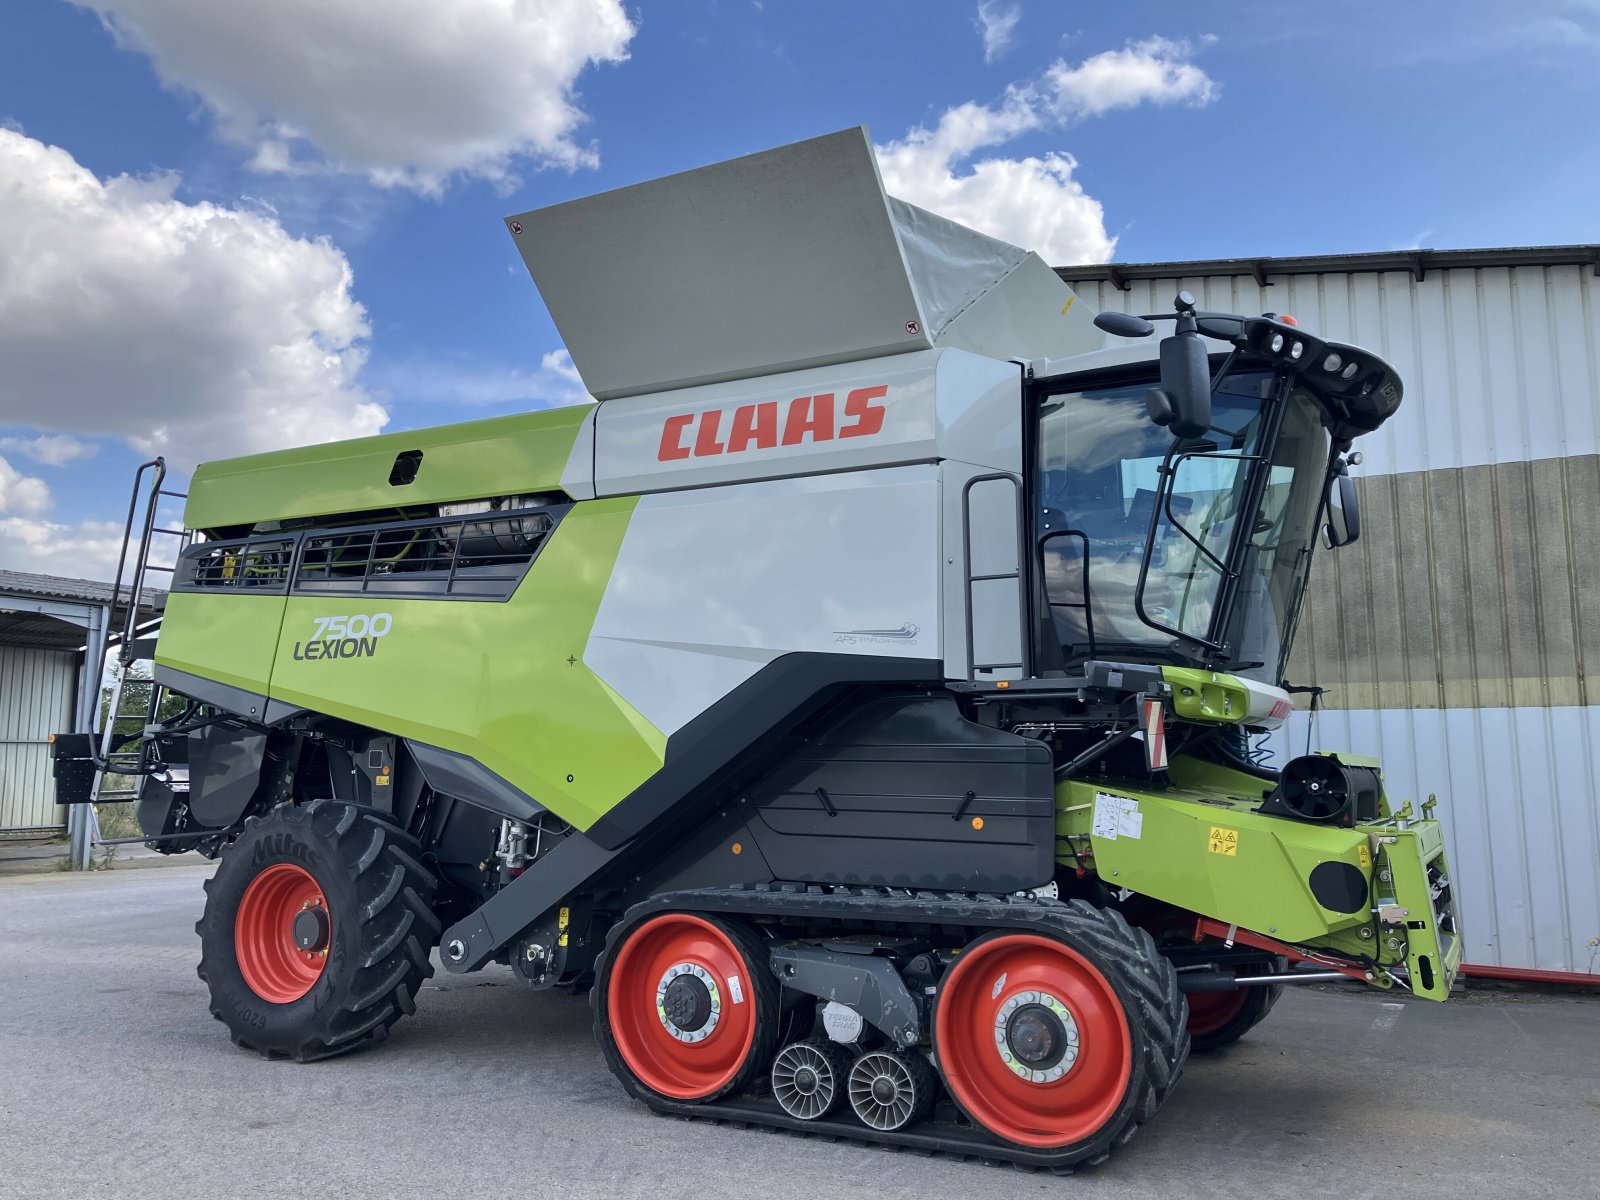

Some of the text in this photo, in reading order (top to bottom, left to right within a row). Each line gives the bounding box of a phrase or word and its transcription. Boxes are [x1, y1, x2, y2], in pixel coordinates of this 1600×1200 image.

[657, 384, 889, 462] CLAAS
[310, 612, 393, 641] 7500
[834, 635, 857, 645] APS
[293, 636, 378, 660] LEXION
[251, 833, 320, 867] Mitas
